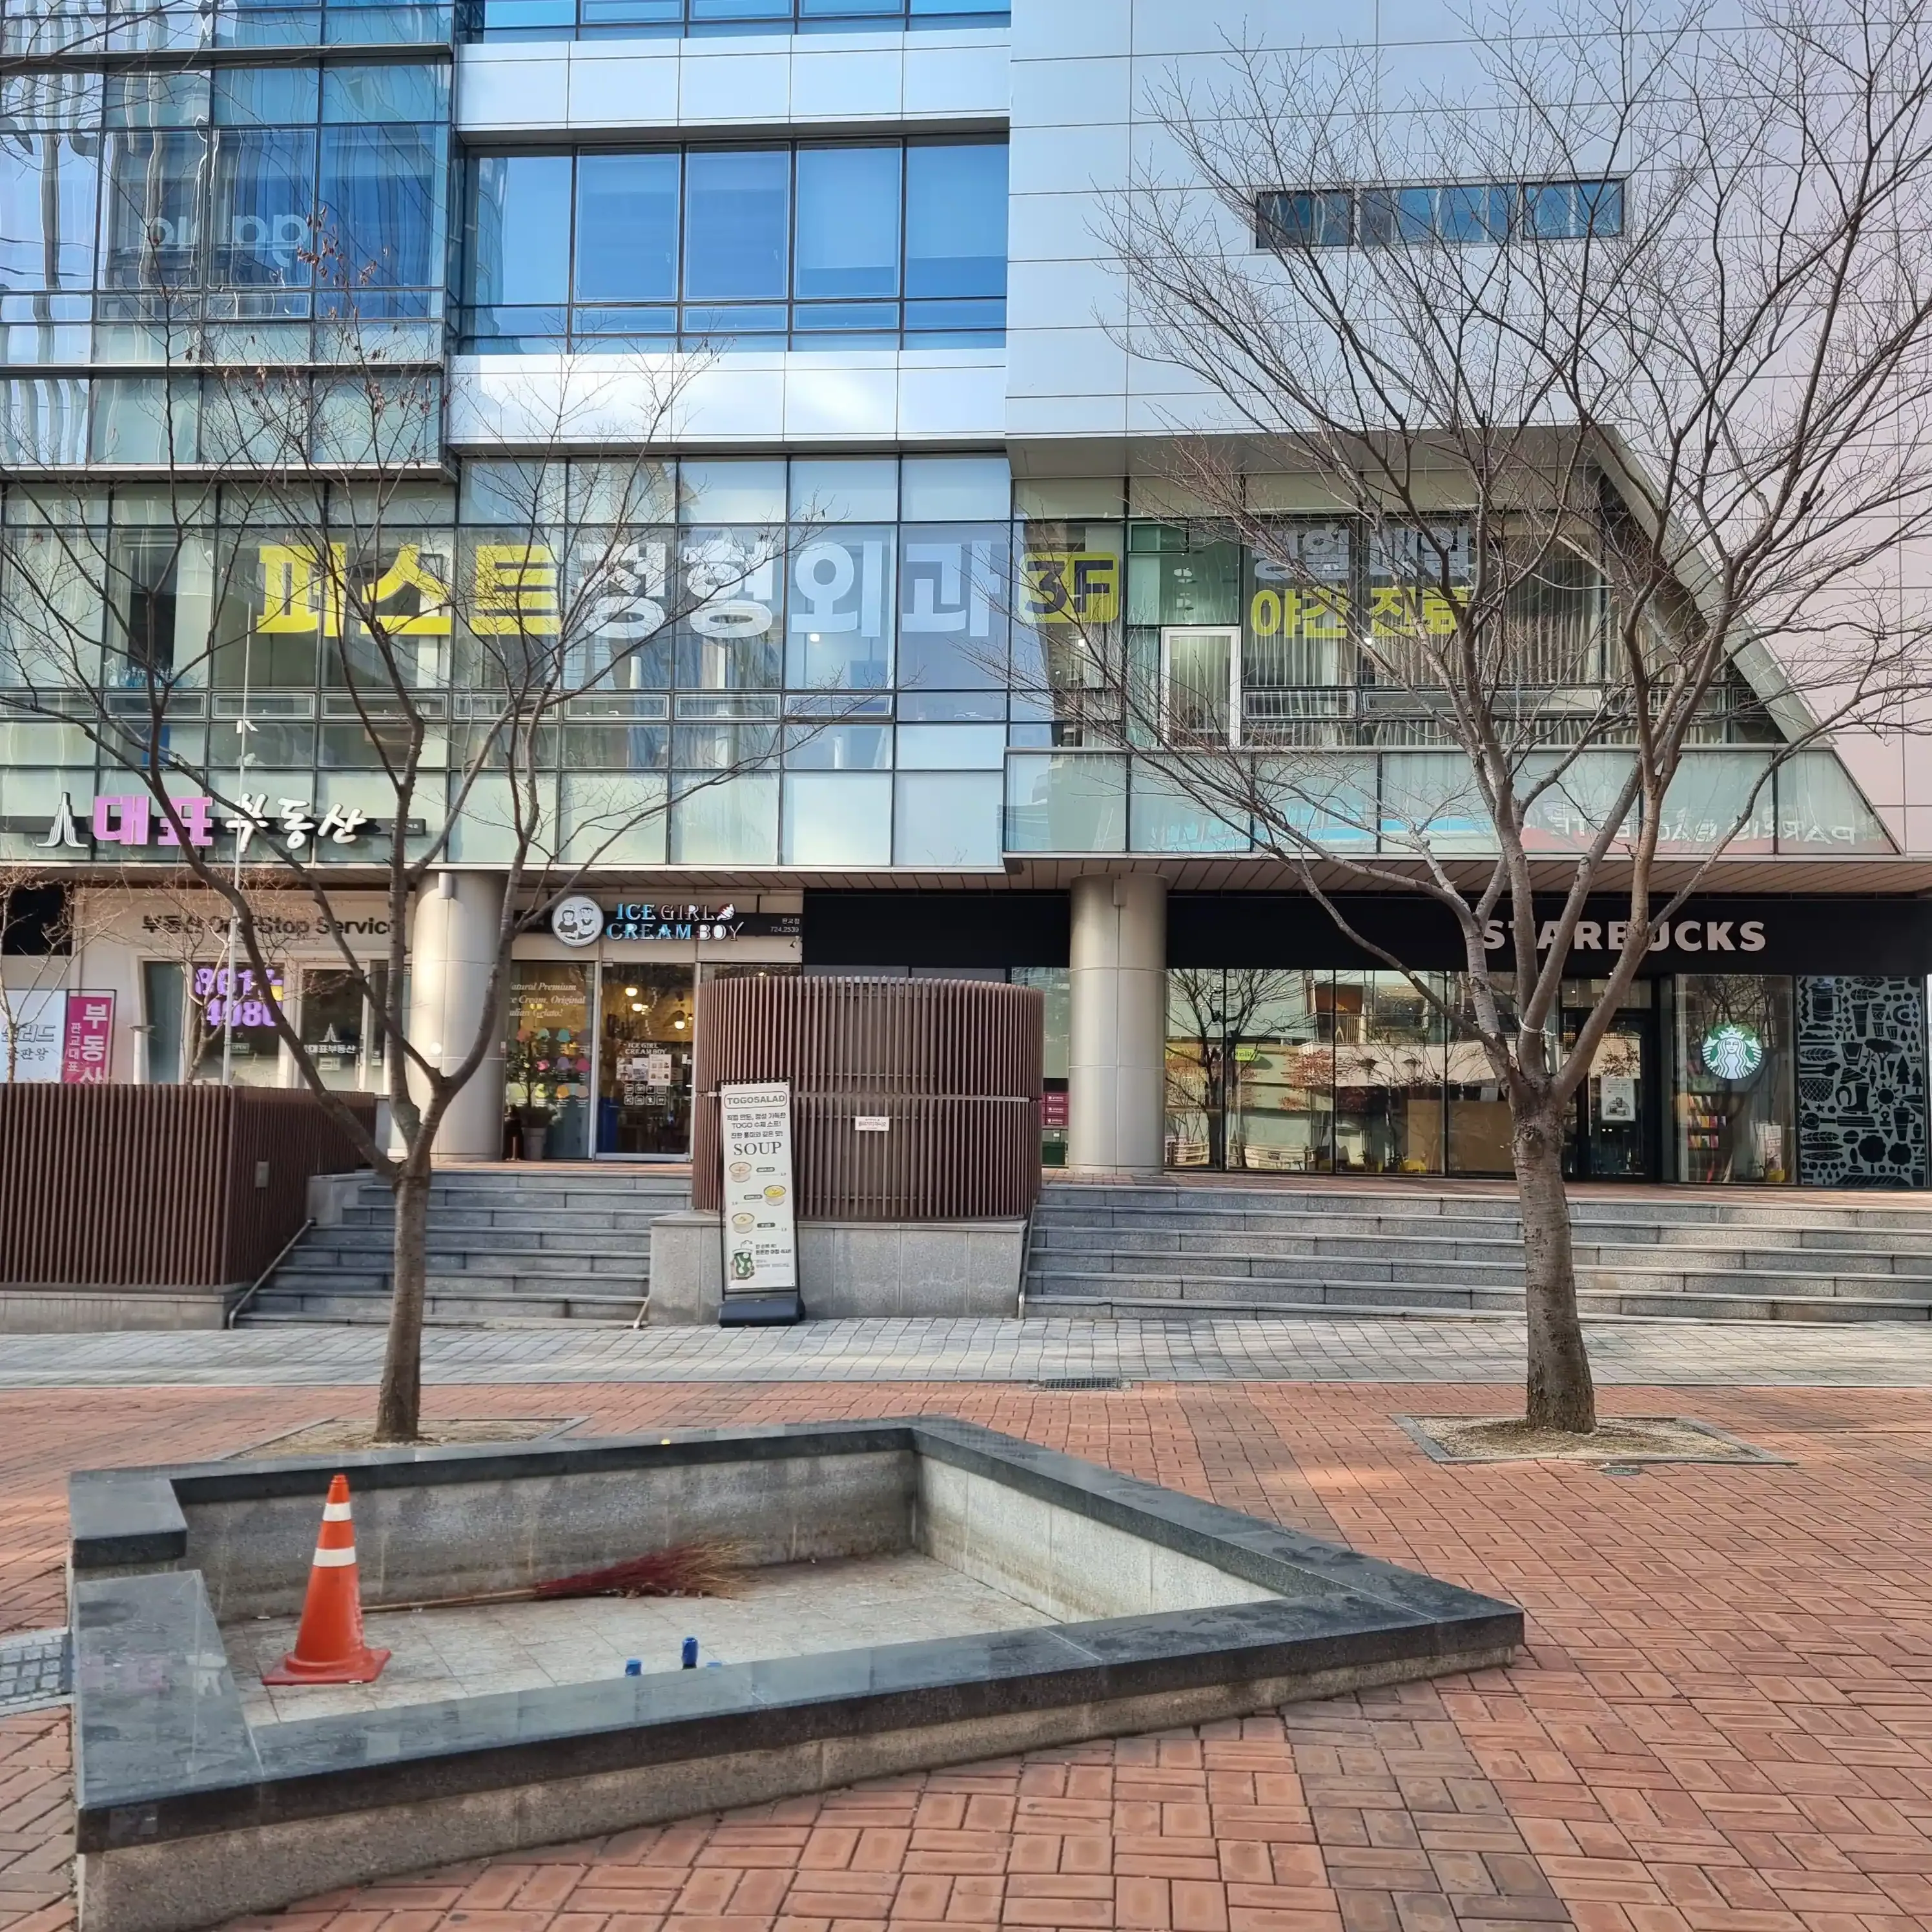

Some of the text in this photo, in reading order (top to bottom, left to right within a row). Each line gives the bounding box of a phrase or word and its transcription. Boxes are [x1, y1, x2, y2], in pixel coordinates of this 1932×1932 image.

[1023, 559, 1112, 615] 3F
[1251, 588, 1348, 639] 야간
[93, 792, 367, 854] 대표 부동산
[615, 903, 715, 921] ICE GIRL
[141, 915, 203, 934] 부동산
[315, 916, 393, 935] Servic
[606, 921, 745, 941] CREAM BOY
[1483, 920, 1767, 952] SARBUCKS
[539, 982, 577, 991] Premium
[551, 995, 586, 1005] Original
[67, 1022, 82, 1073] 판교대표
[727, 1095, 785, 1104] TOGOSALAD
[734, 1142, 781, 1155] SOUP
